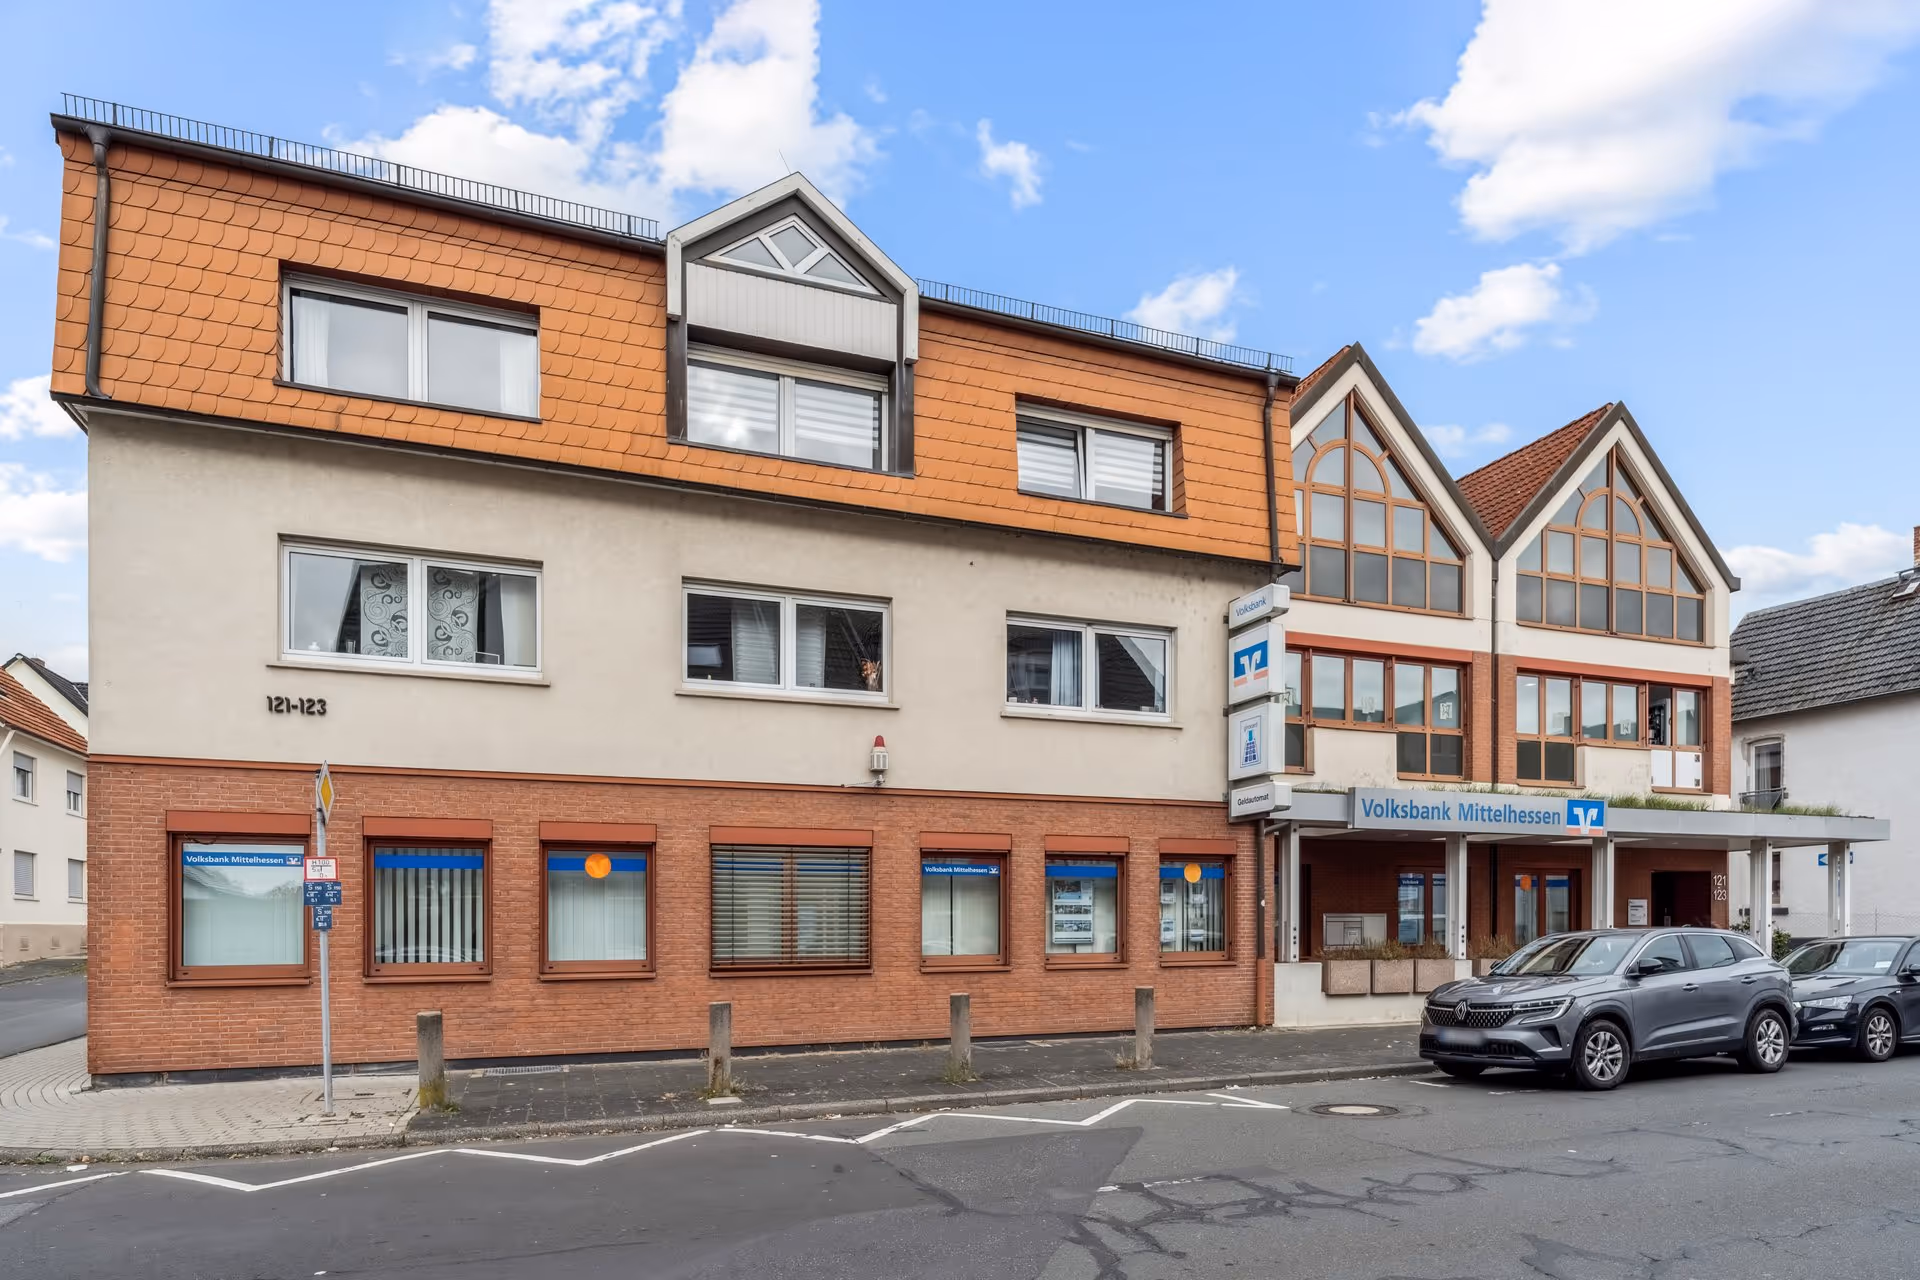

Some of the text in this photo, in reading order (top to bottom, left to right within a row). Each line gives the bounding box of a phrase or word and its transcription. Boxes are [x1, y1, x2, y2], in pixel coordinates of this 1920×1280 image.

[1235, 595, 1267, 616] Volksbank
[266, 695, 327, 716] 121-123
[1237, 793, 1269, 806] Geldautomat
[1361, 798, 1561, 825] Volksbank Mittelhessen
[186, 855, 284, 864] Volksbank Mittelhessen
[1713, 874, 1726, 886] 121
[1713, 889, 1727, 901] 123
